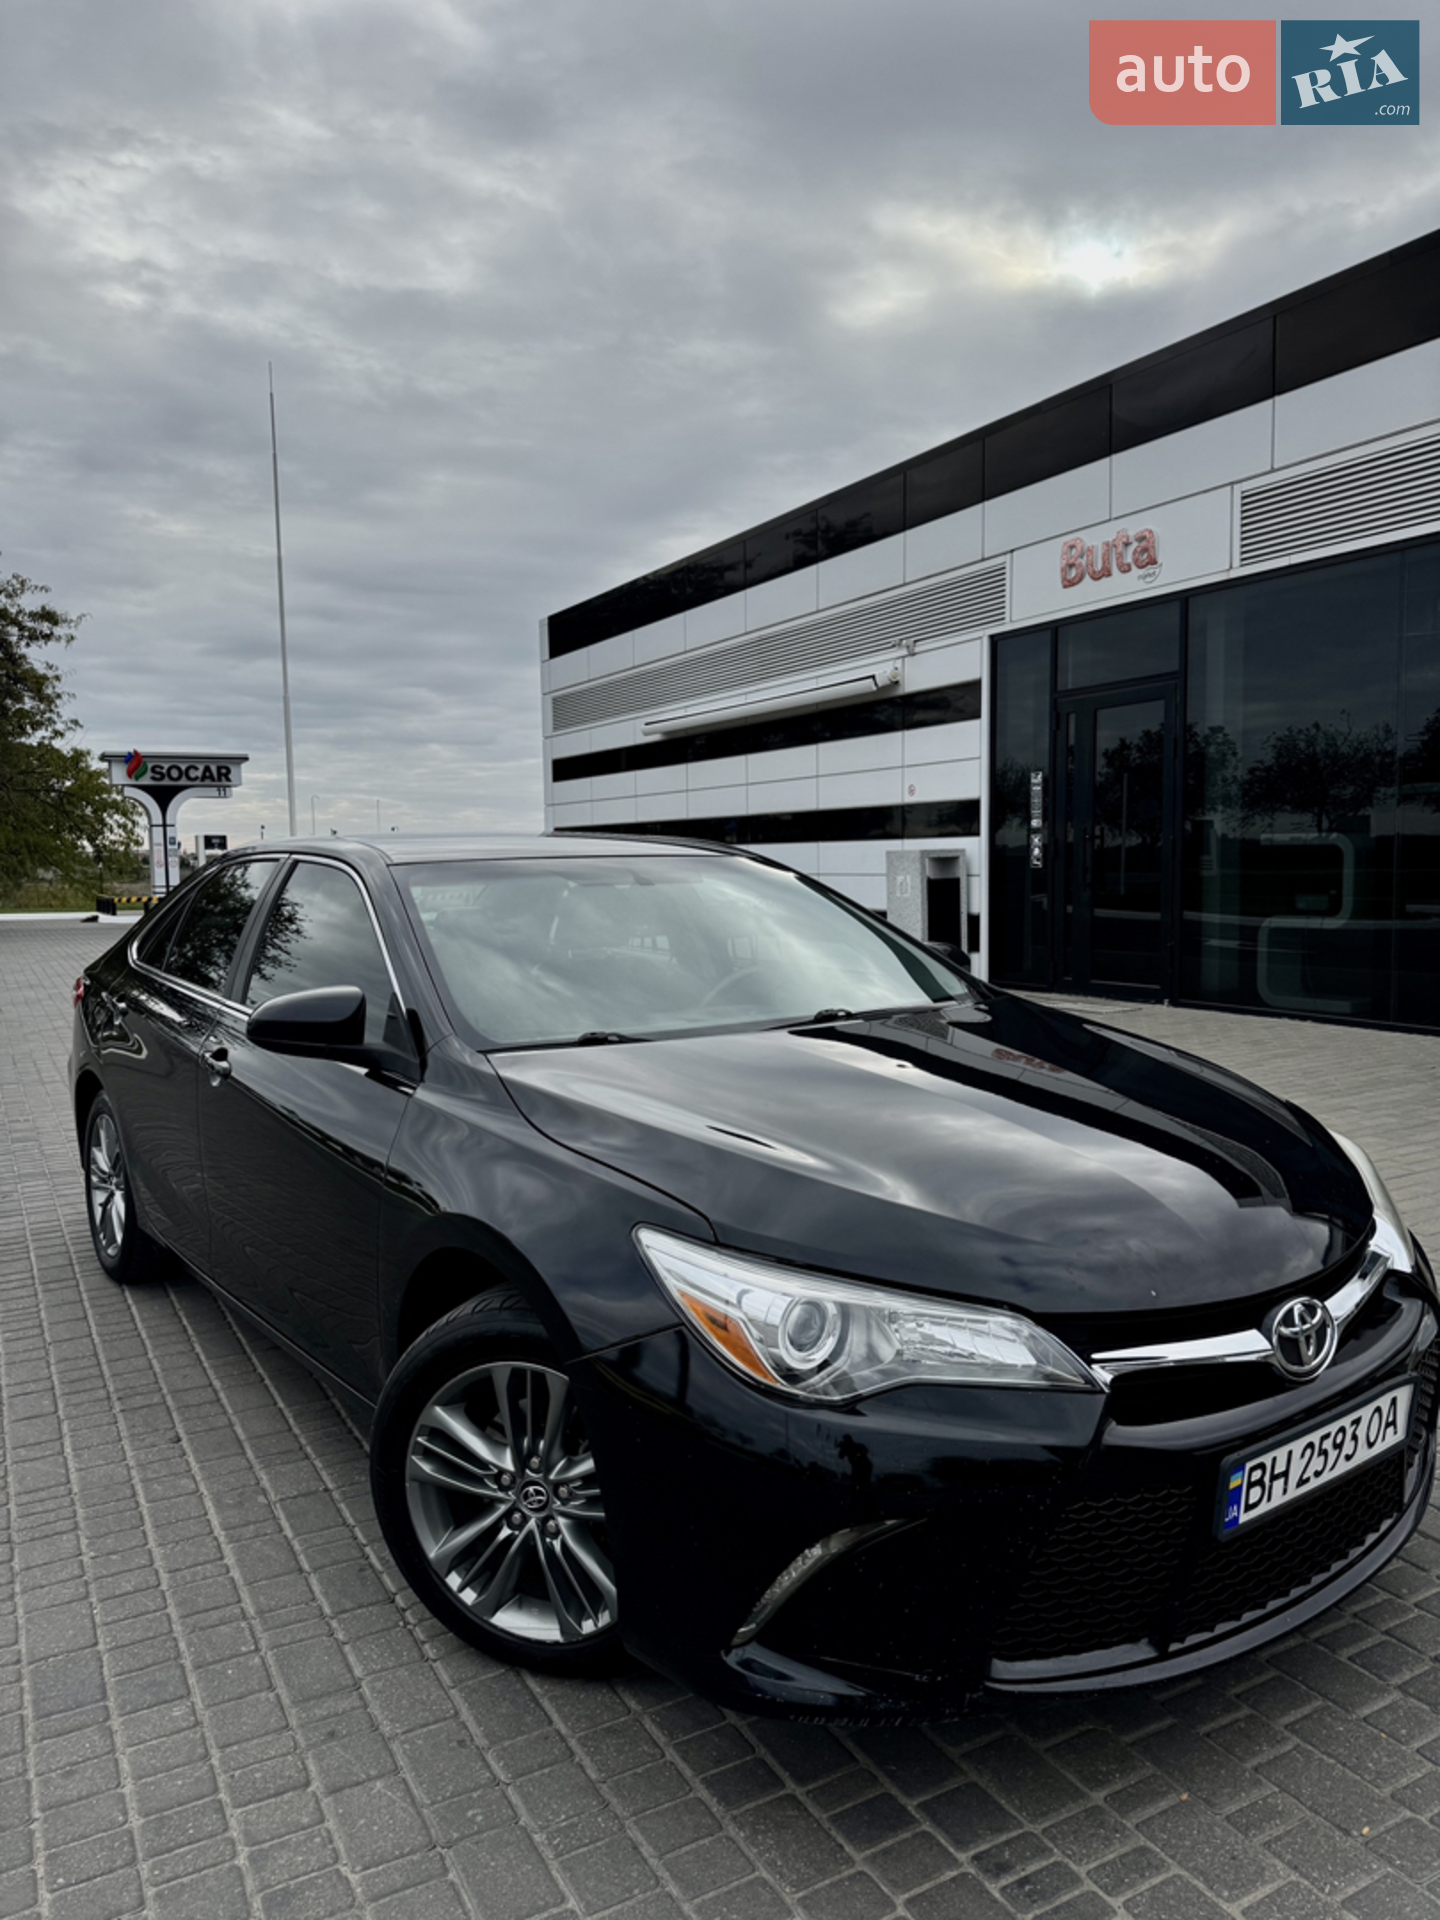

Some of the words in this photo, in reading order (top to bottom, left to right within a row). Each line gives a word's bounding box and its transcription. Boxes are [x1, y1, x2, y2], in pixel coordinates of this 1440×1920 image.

[1060, 528, 1158, 589] Buta
[150, 764, 232, 783] SOCAR
[1243, 1449, 1293, 1514] BH
[1295, 1415, 1362, 1490] 2593
[1366, 1395, 1398, 1449] OA
